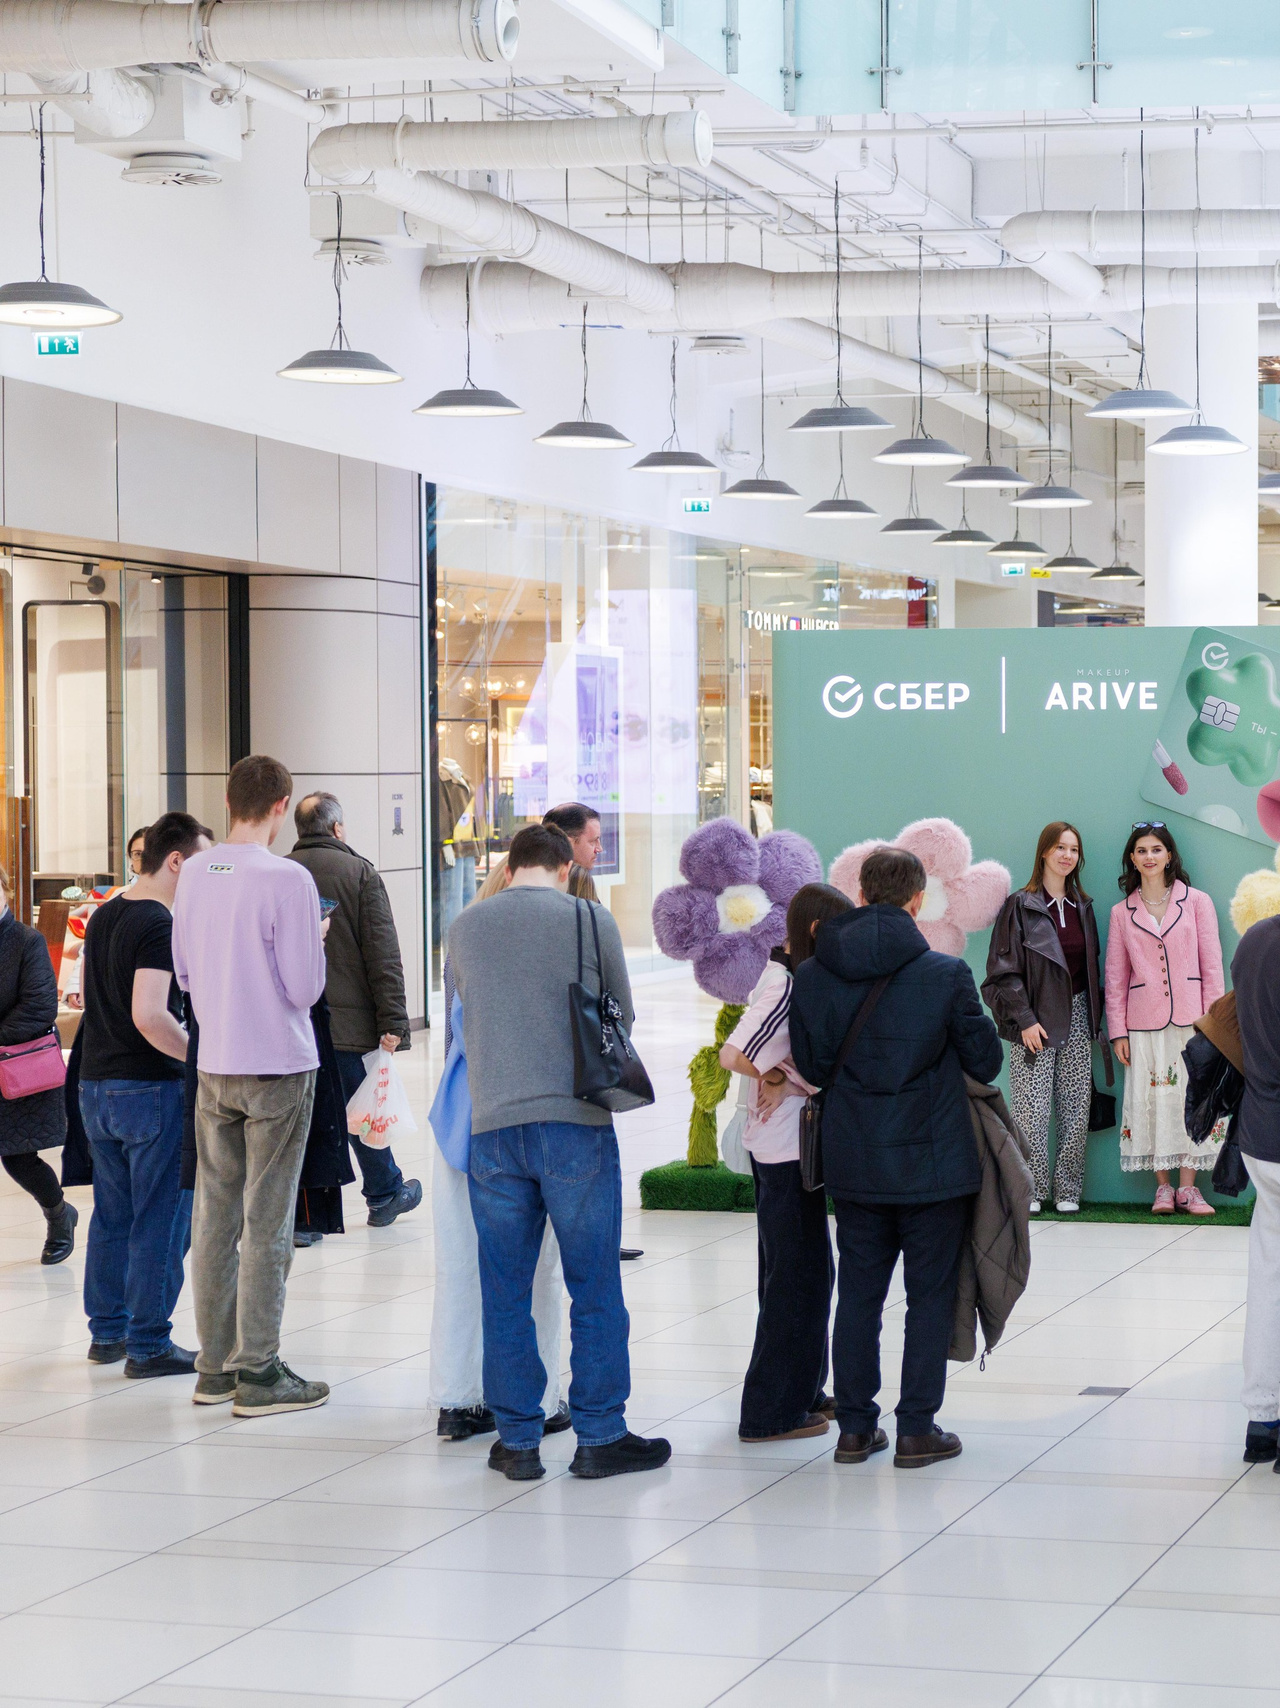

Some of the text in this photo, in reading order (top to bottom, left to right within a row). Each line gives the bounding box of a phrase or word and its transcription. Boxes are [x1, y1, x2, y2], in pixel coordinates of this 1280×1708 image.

[747, 610, 788, 631] TOMMY
[1076, 668, 1131, 677] MAKEUP
[873, 682, 970, 711] СБЕР
[1044, 682, 1158, 710] ARIVE
[1251, 722, 1267, 736] ты
